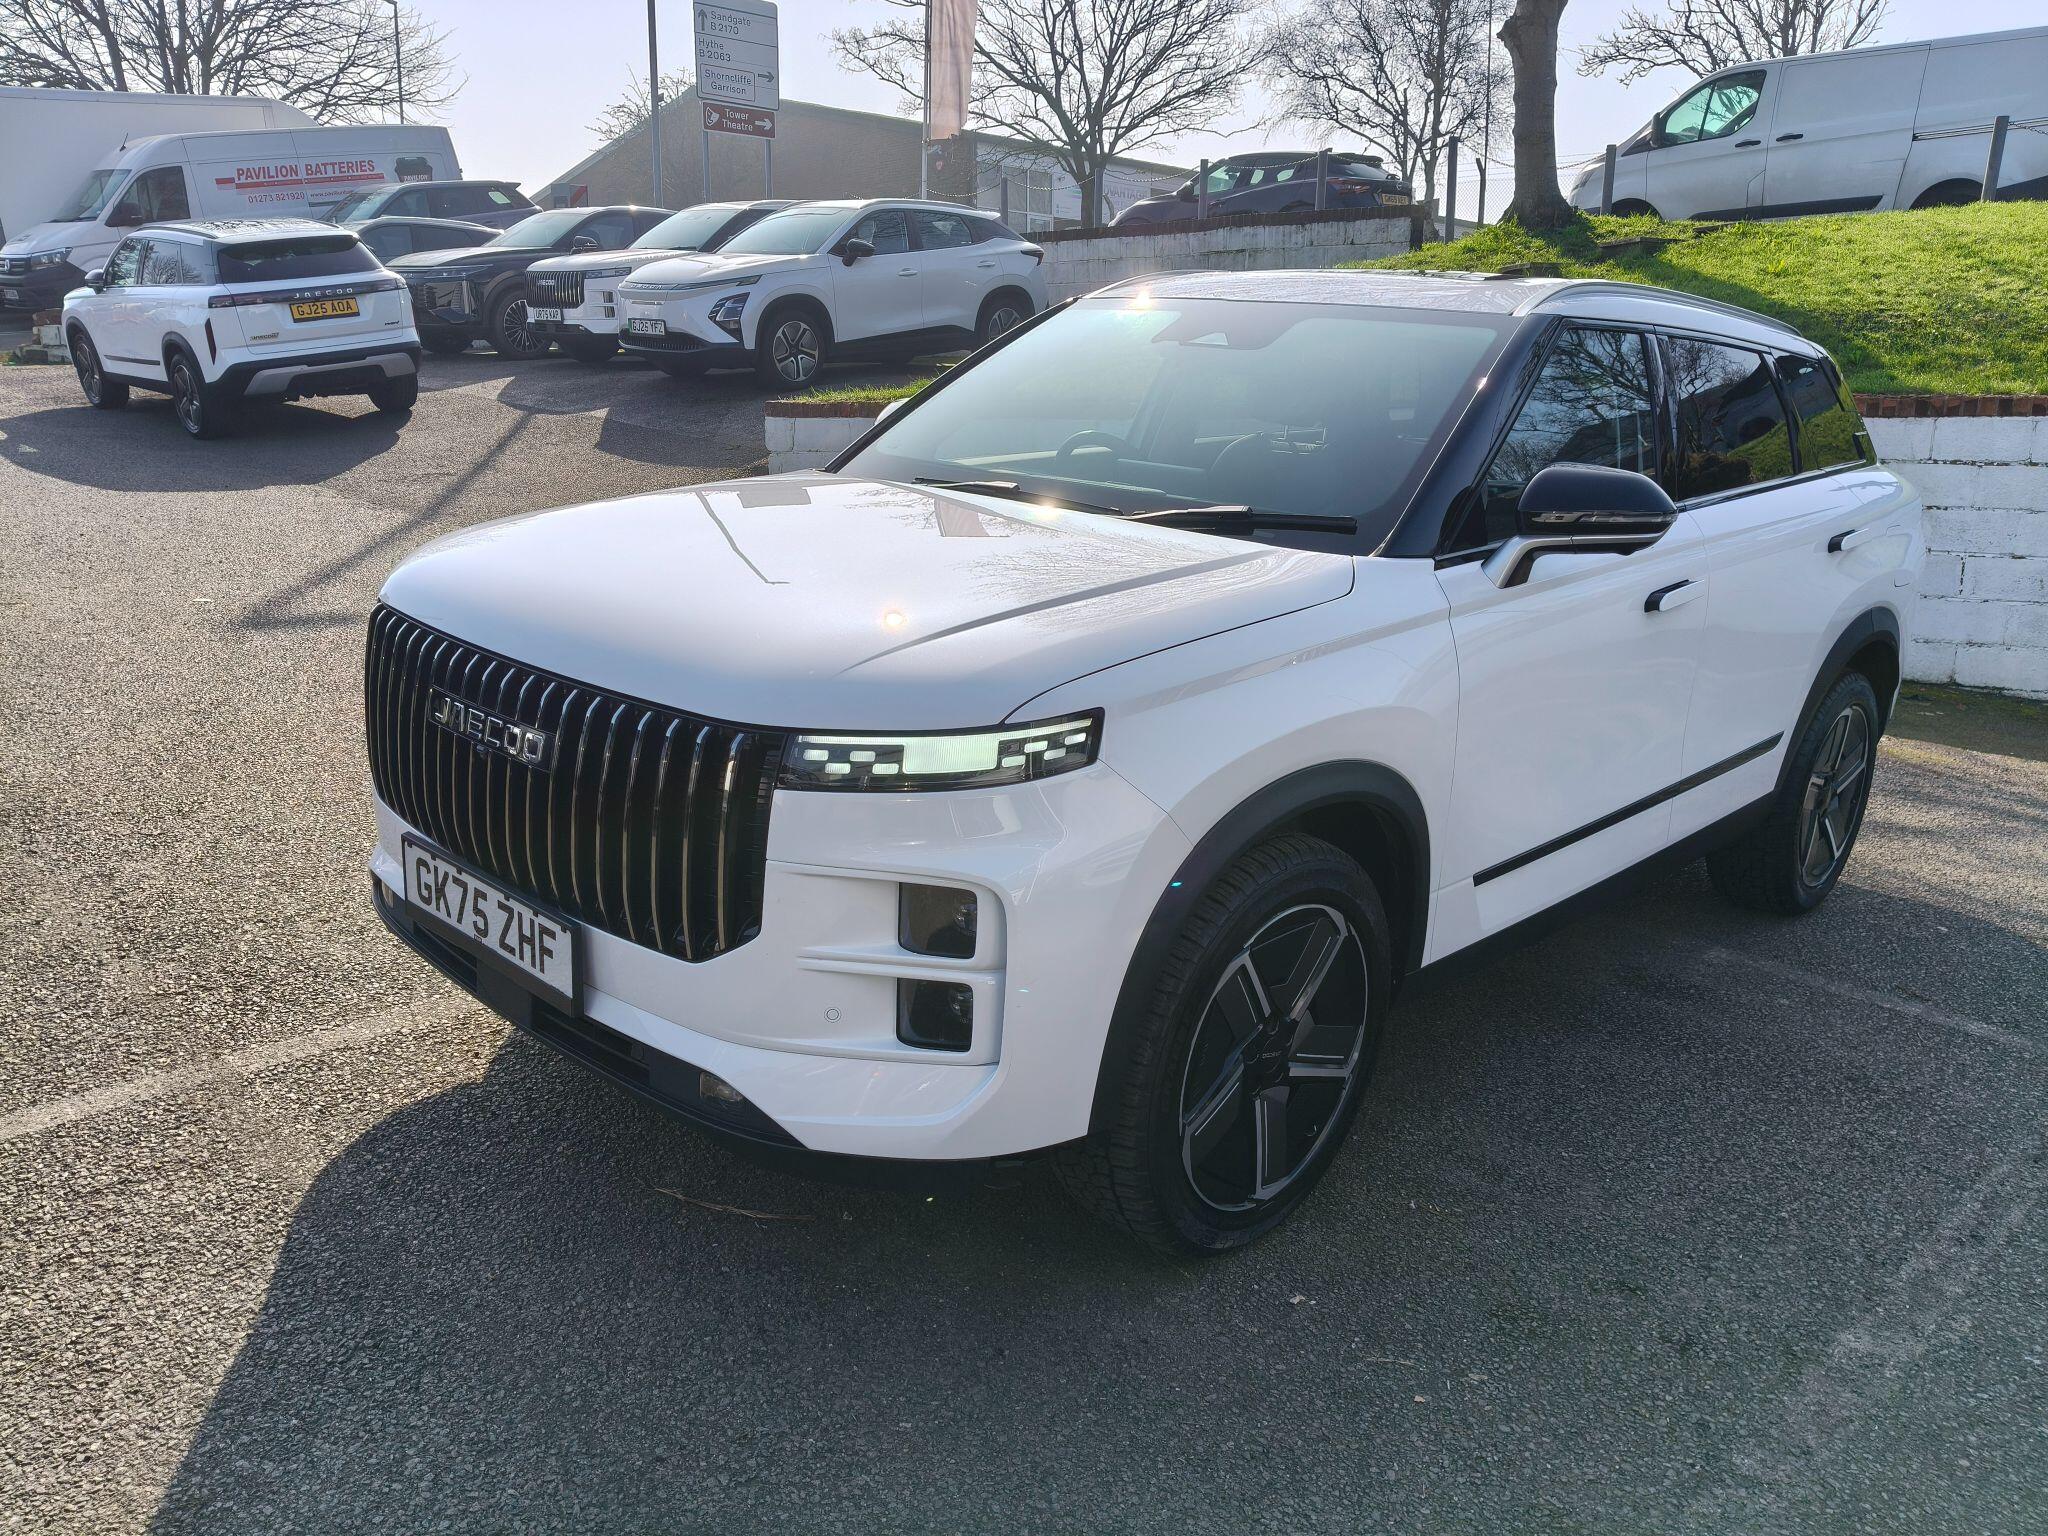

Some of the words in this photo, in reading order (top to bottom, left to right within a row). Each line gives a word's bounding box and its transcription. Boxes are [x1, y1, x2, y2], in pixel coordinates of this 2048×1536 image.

[710, 10, 751, 27] Sandgate
[710, 22, 716, 31] B
[718, 23, 739, 35] 2170
[698, 37, 724, 50] Hythe
[699, 49, 705, 58] B
[707, 50, 731, 62] 2063
[704, 69, 752, 85] Shorncliffe
[710, 81, 746, 95] Garrison
[724, 108, 749, 120] Tower
[721, 119, 753, 132] Theatre
[236, 164, 299, 181] PAVILION
[304, 159, 376, 177] BATTERIES
[247, 194, 274, 204] 01273
[294, 287, 353, 299] JAECOO
[296, 303, 328, 316] GJ25
[632, 320, 649, 333] GJ25
[434, 697, 544, 761] JAECOO
[414, 856, 489, 940] GK75
[496, 899, 557, 974] ZHF
